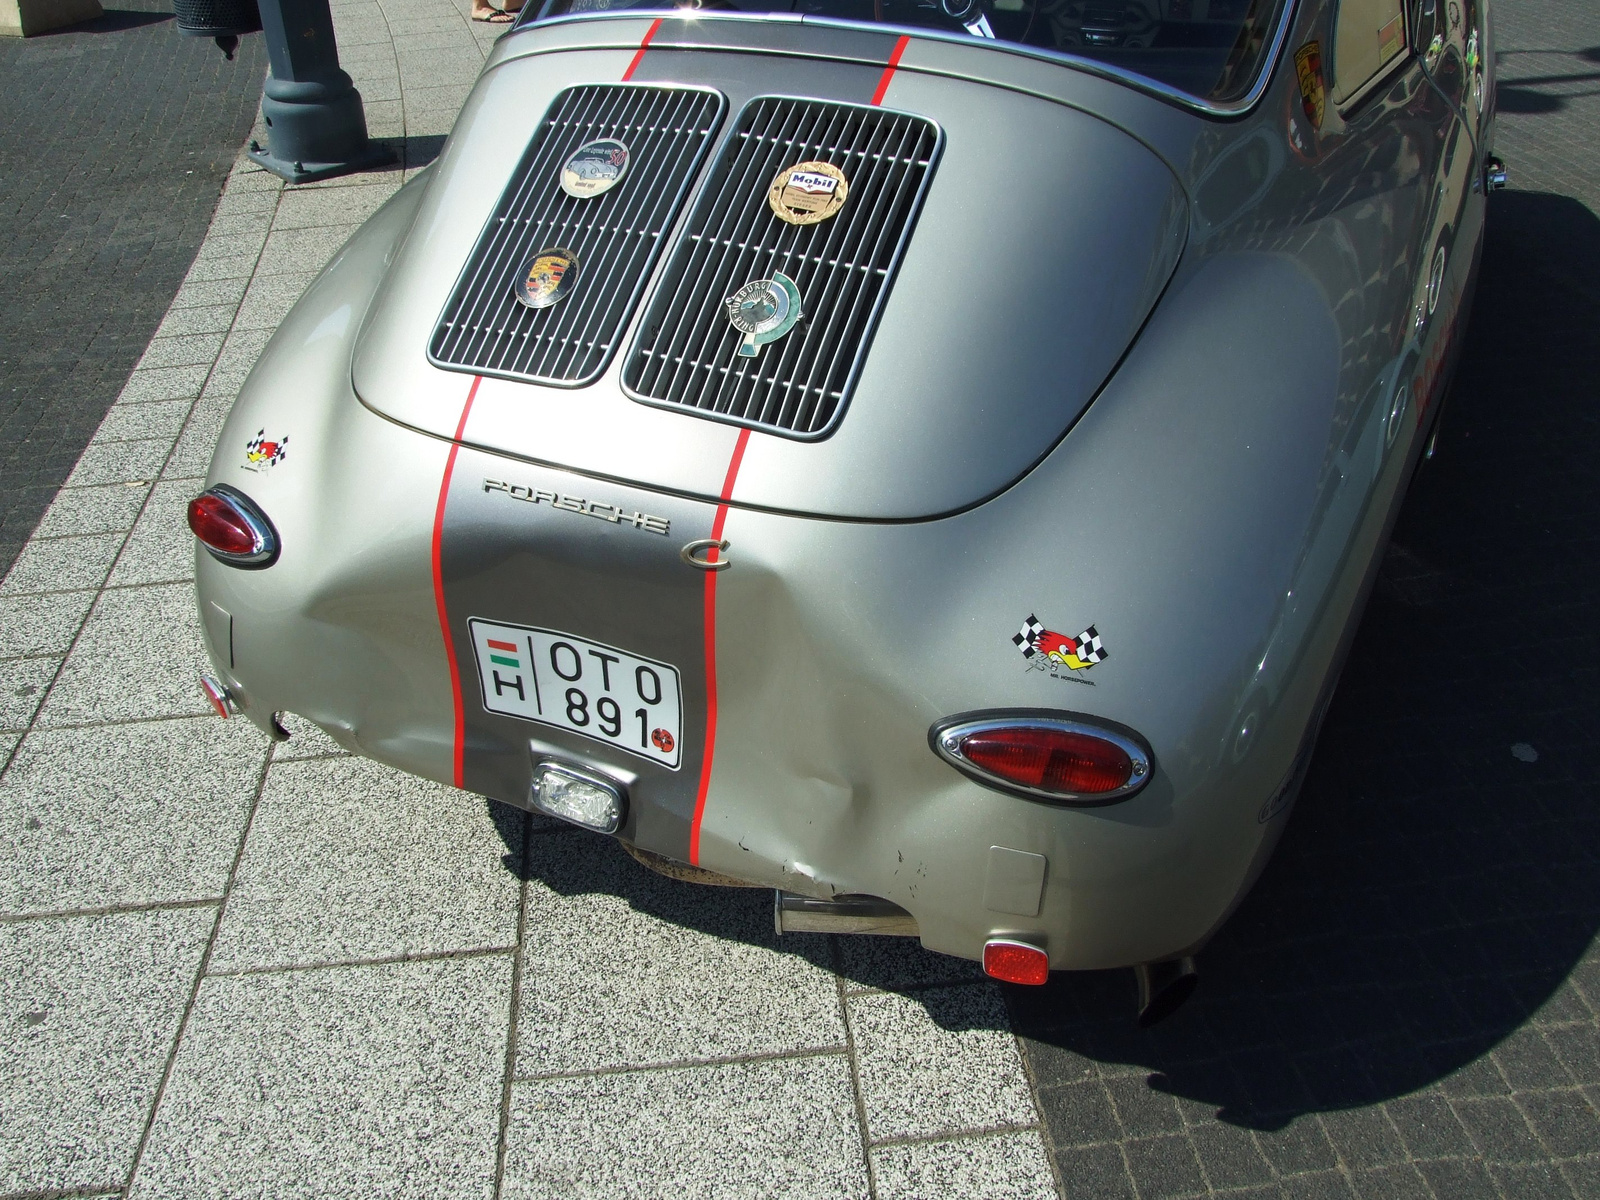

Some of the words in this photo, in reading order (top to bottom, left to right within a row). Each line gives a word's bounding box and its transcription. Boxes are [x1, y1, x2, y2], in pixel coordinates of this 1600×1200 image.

[606, 149, 628, 167] 50
[792, 174, 833, 188] Mobil
[482, 477, 671, 535] PORSCHE
[680, 538, 732, 571] C
[493, 670, 525, 701] H
[565, 687, 648, 749] 891
